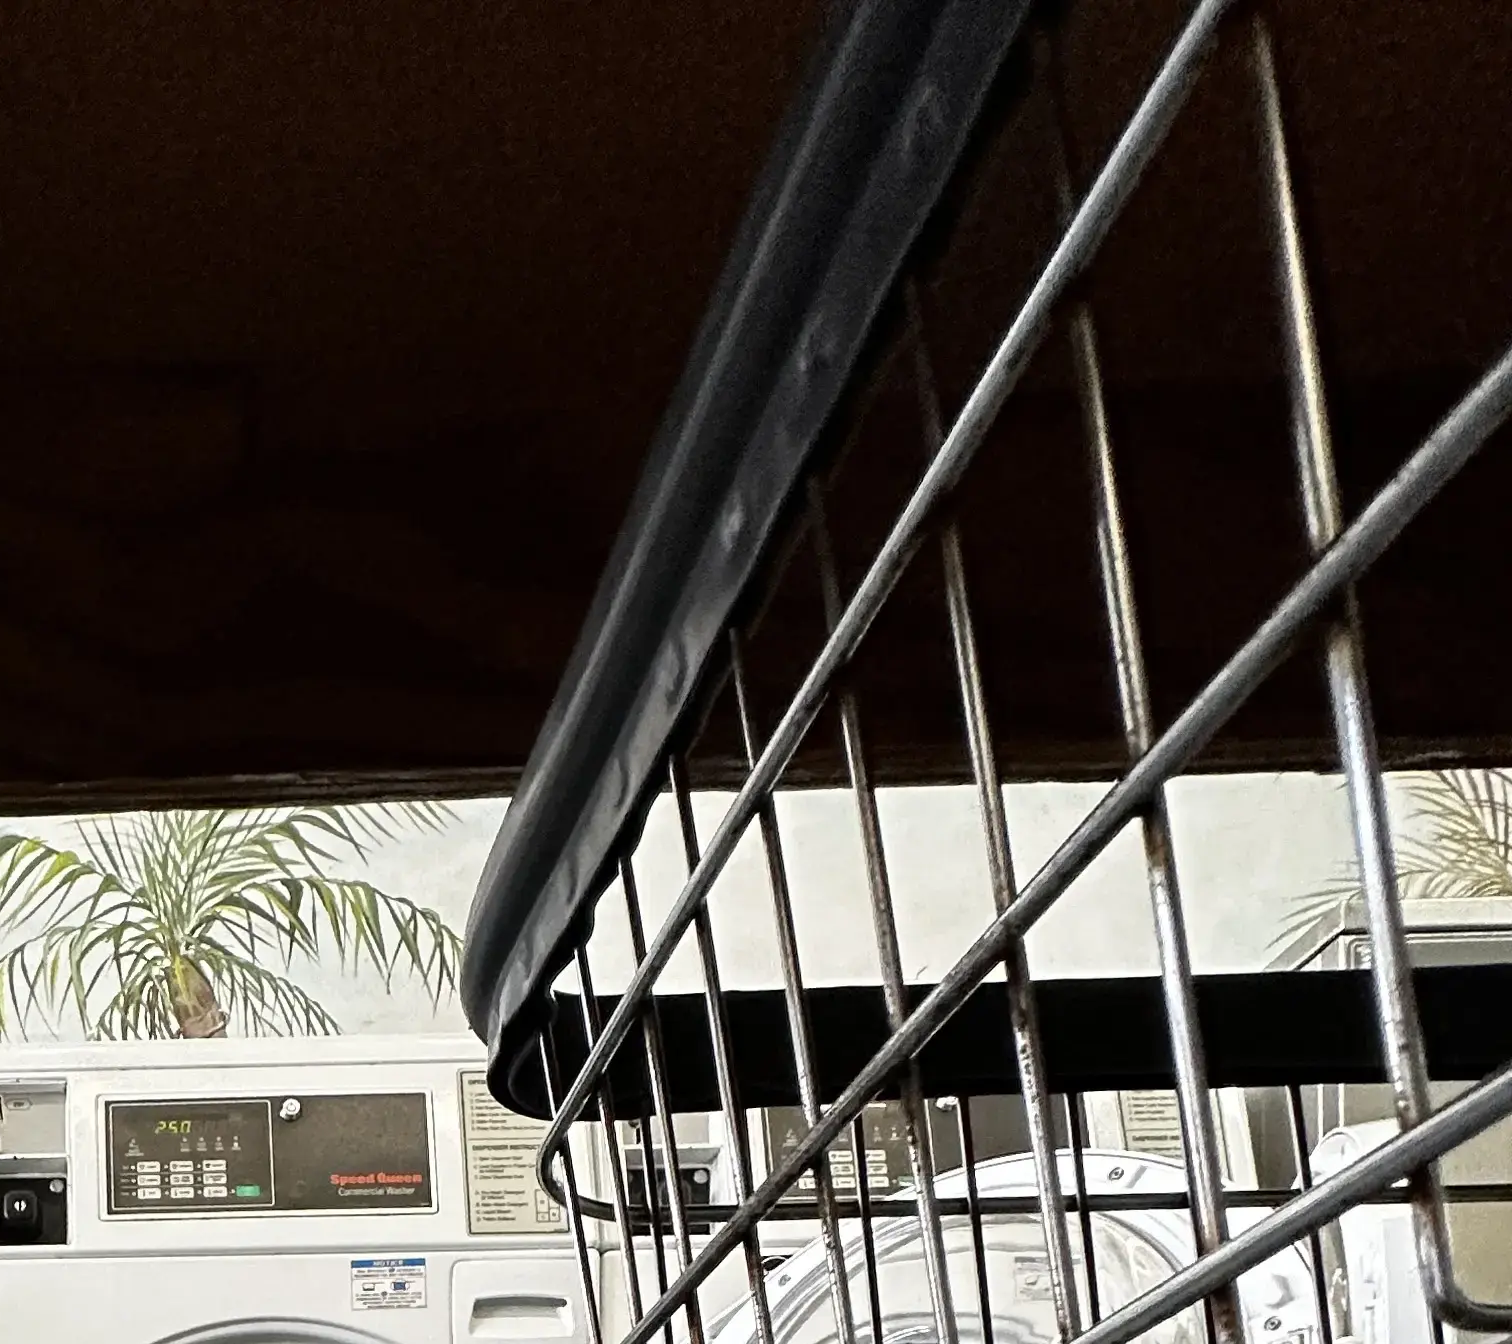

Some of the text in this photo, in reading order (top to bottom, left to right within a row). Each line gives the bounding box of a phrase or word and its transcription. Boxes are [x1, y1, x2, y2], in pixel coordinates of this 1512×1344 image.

[330, 1172, 422, 1186] Speed Queen
[373, 1259, 403, 1267] NOTICE
